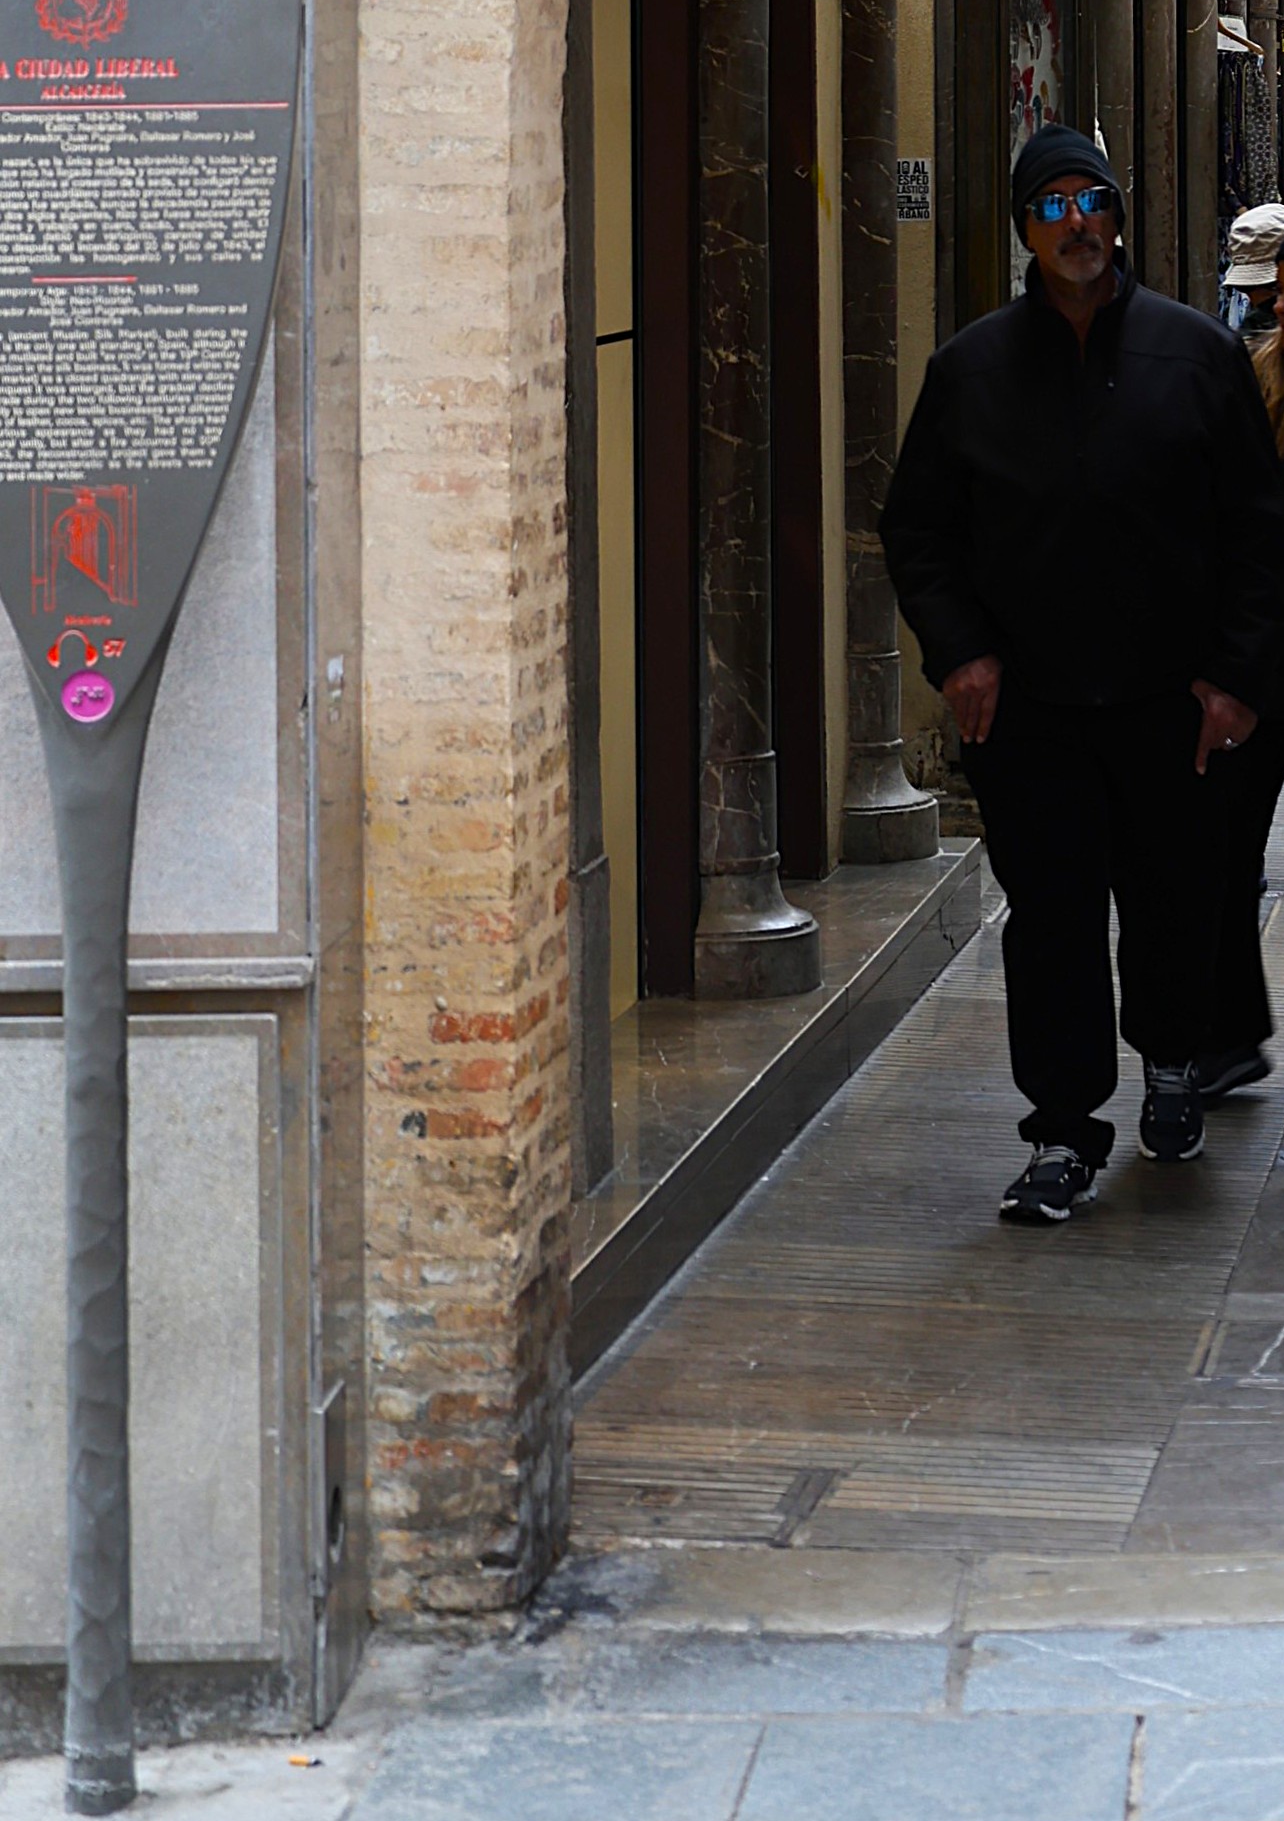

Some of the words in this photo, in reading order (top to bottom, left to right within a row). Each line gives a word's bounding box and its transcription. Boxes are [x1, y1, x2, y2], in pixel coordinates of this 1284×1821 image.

[15, 58, 91, 80] CIUDAD
[95, 56, 180, 79] LIBERAL
[912, 161, 929, 175] AL
[102, 638, 127, 659] 57
